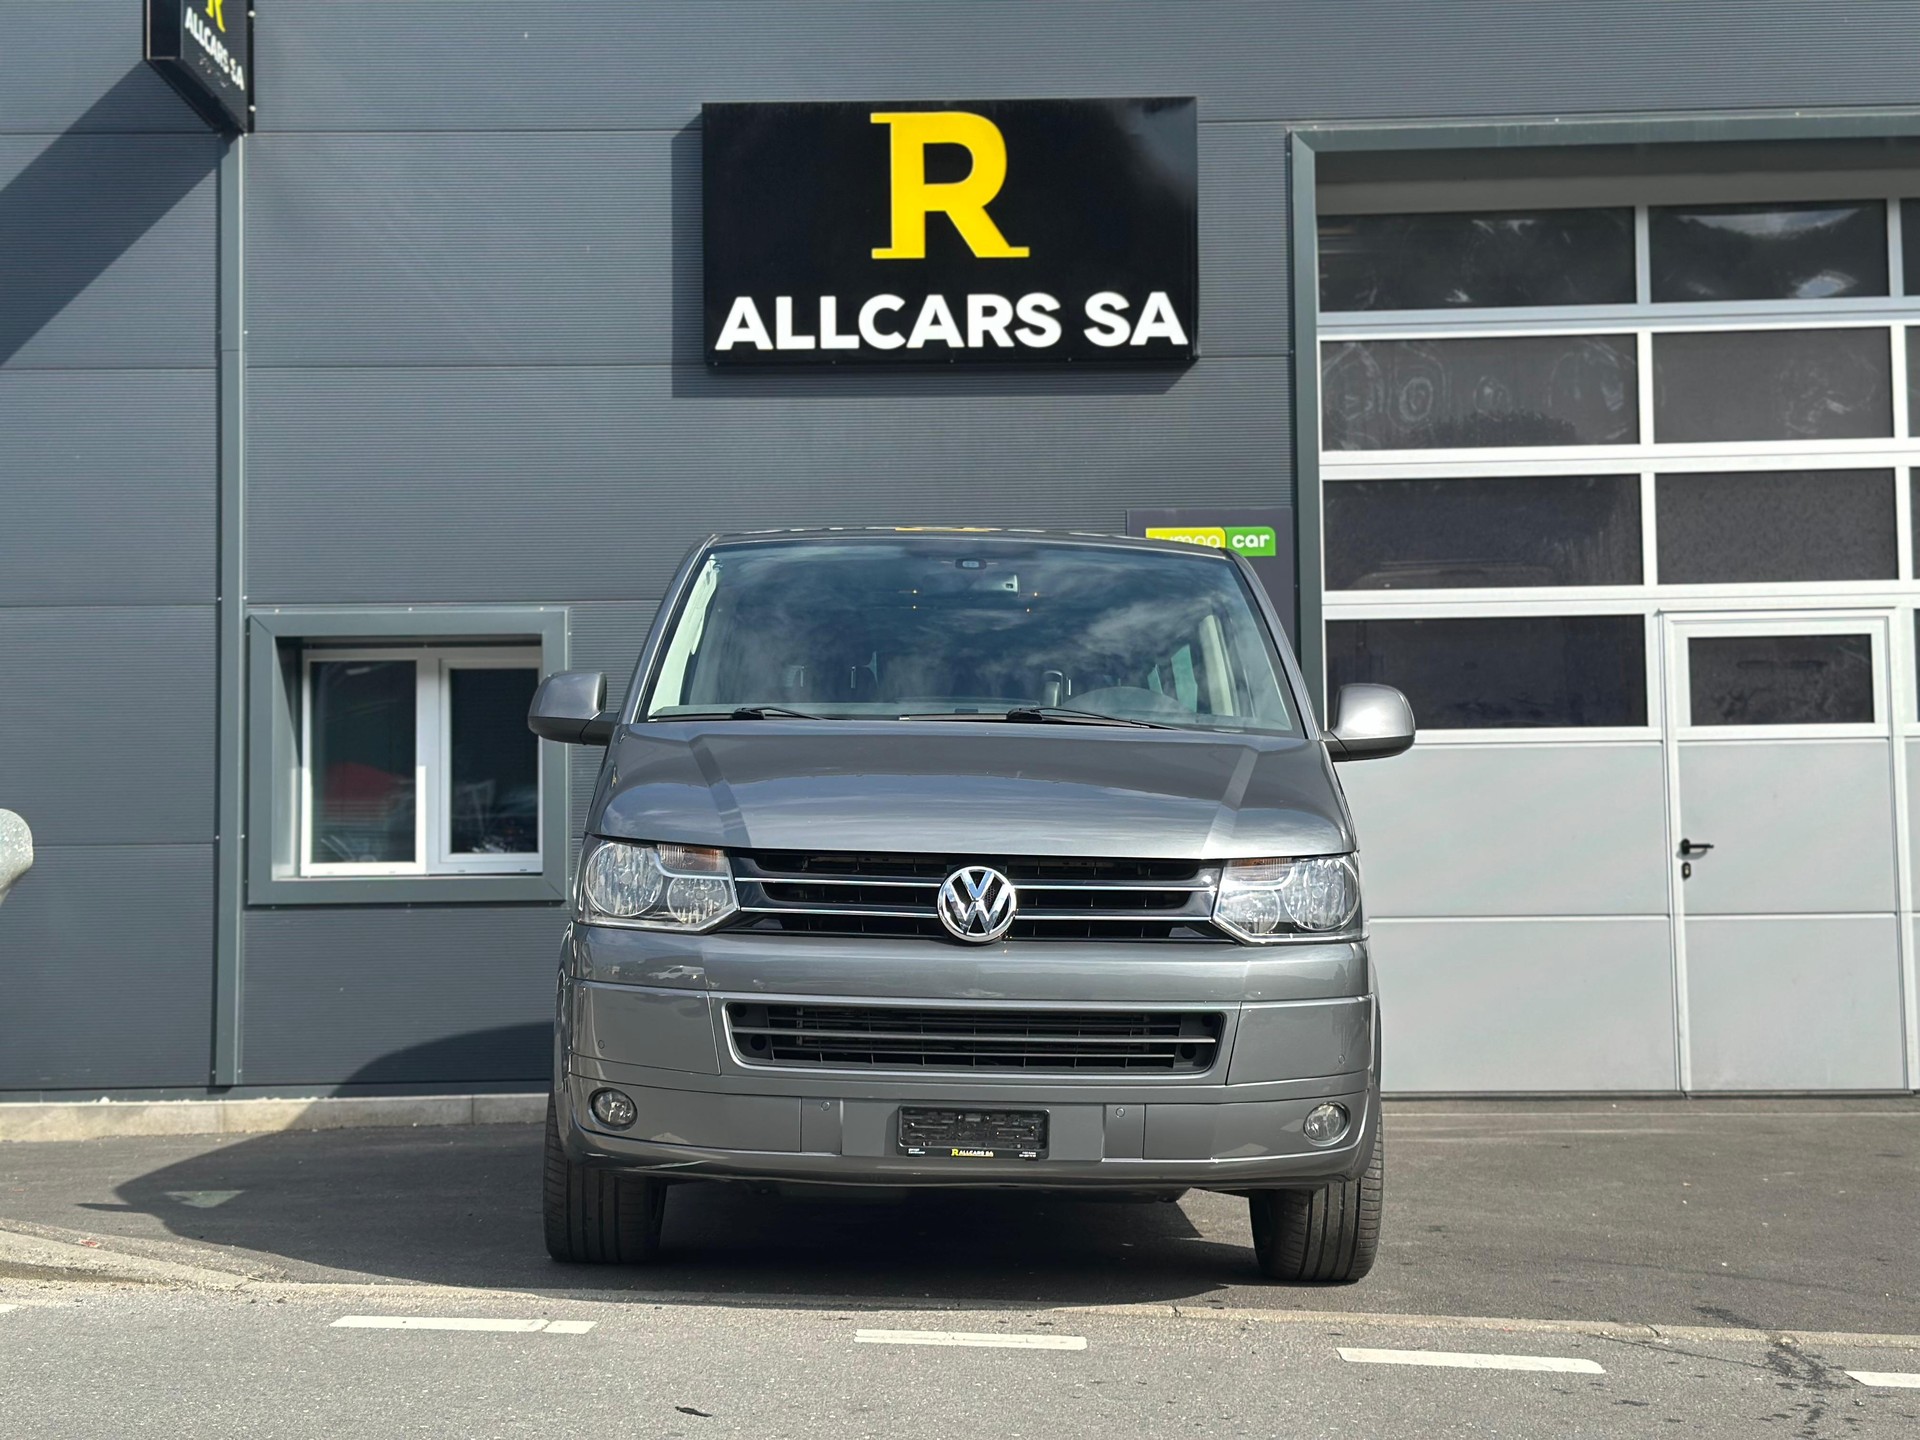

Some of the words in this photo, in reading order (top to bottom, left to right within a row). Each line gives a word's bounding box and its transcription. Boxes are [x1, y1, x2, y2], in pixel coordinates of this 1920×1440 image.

[184, 7, 229, 74] ALLCARS
[229, 58, 245, 90] SA
[871, 111, 1030, 259] R
[715, 292, 1062, 351] ALLCARS
[1083, 291, 1189, 348] SA
[1231, 534, 1270, 548] car
